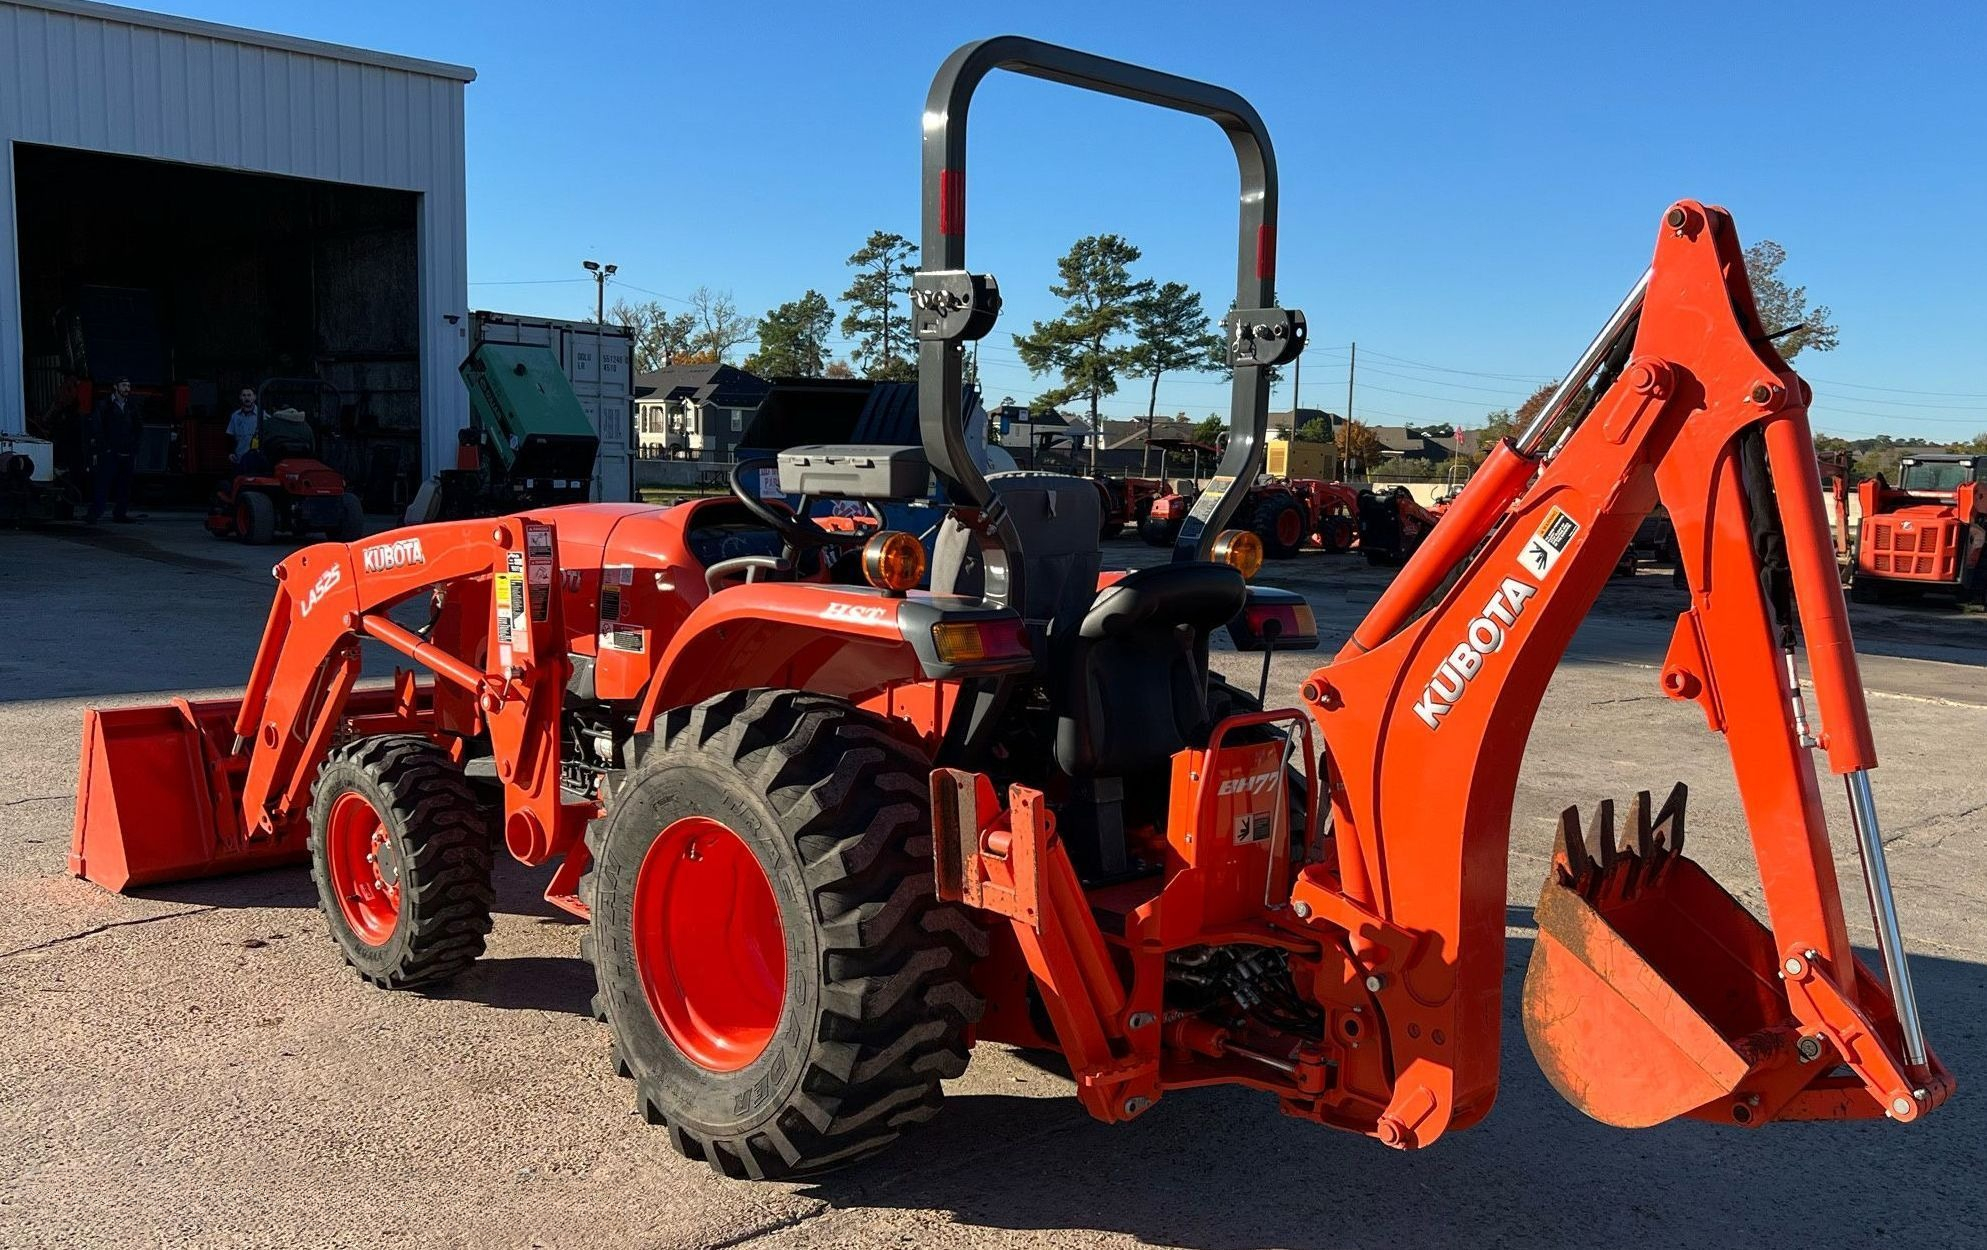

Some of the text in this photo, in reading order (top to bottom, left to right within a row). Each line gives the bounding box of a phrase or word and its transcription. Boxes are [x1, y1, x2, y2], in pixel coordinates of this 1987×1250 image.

[363, 539, 424, 574] KUBOTA
[301, 562, 341, 618] LA525
[1412, 576, 1538, 731] KUBOTA
[1217, 770, 1280, 796] BH77
